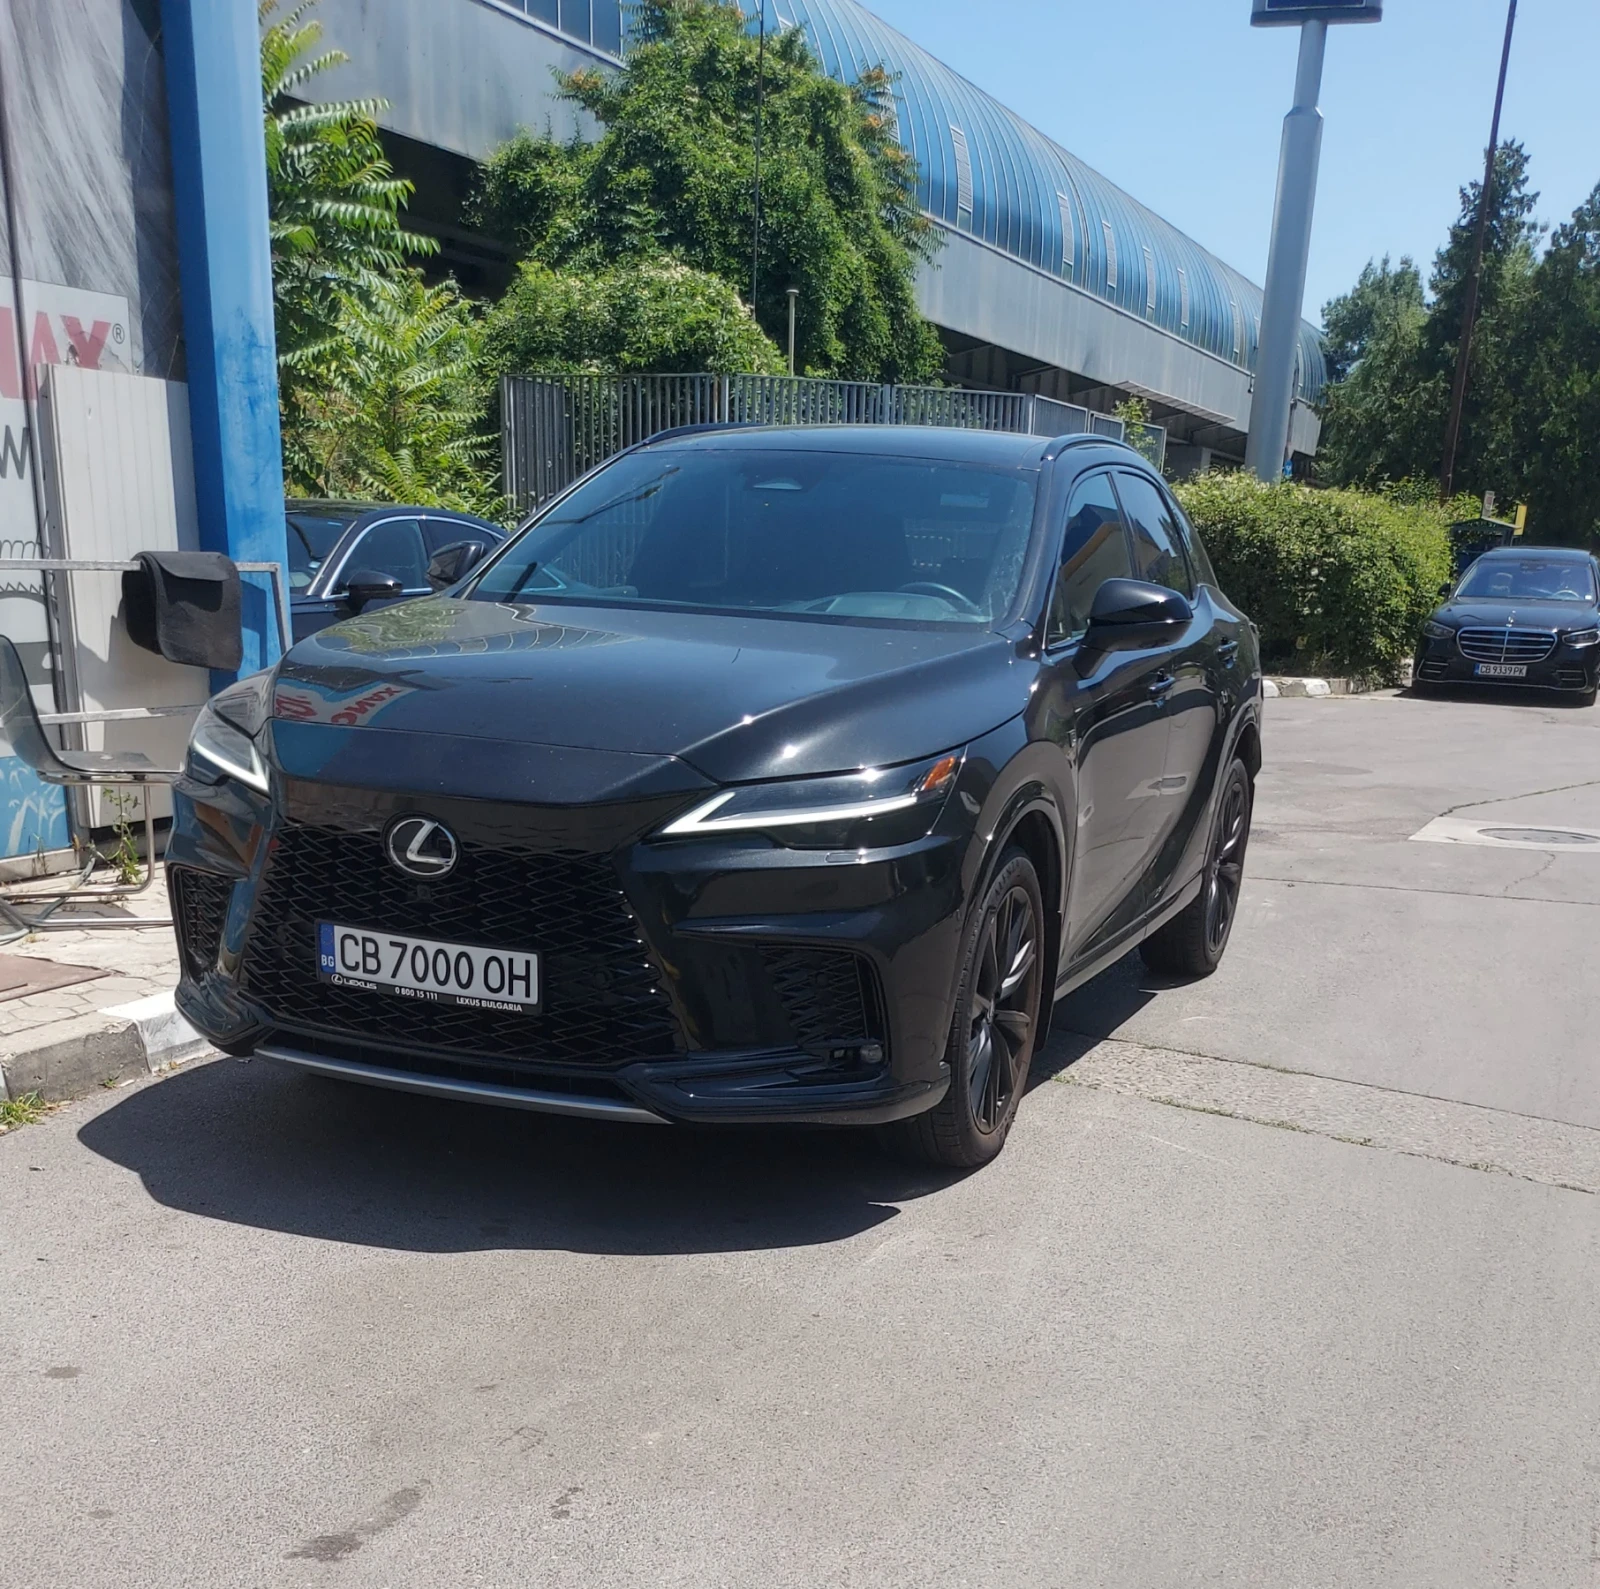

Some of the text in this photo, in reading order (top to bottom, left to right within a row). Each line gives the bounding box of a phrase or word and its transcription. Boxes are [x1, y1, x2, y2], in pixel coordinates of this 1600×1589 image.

[1481, 665, 1525, 676] CB 9339 PK
[321, 954, 334, 967] BG
[340, 933, 531, 998] CB 7000 OH
[343, 977, 378, 990] LEXUS
[395, 987, 438, 1000] 0 800 15 111
[456, 996, 523, 1012] LEXUS BULGARIA
